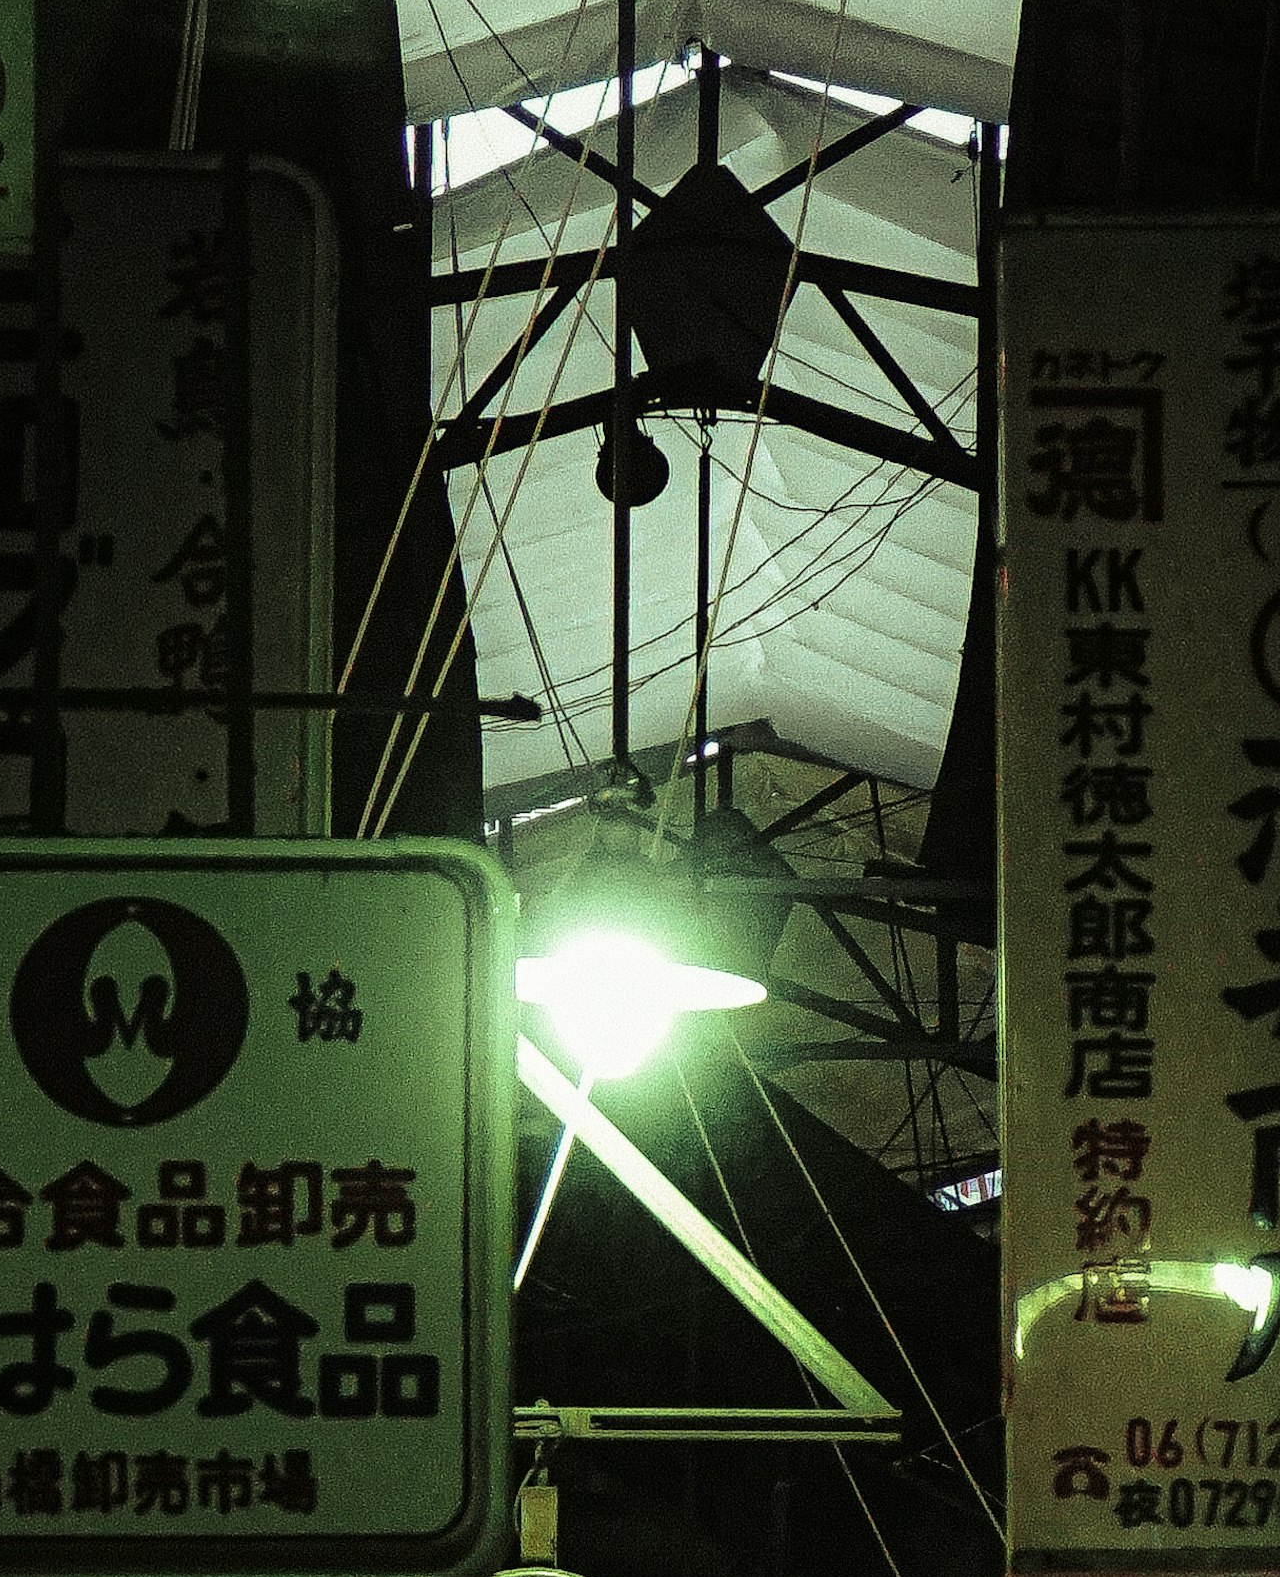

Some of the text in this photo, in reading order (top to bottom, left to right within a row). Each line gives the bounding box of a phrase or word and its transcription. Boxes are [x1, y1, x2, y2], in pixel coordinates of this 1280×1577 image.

[289, 969, 364, 1045] 協
[1072, 1118, 1153, 1324] 特約店
